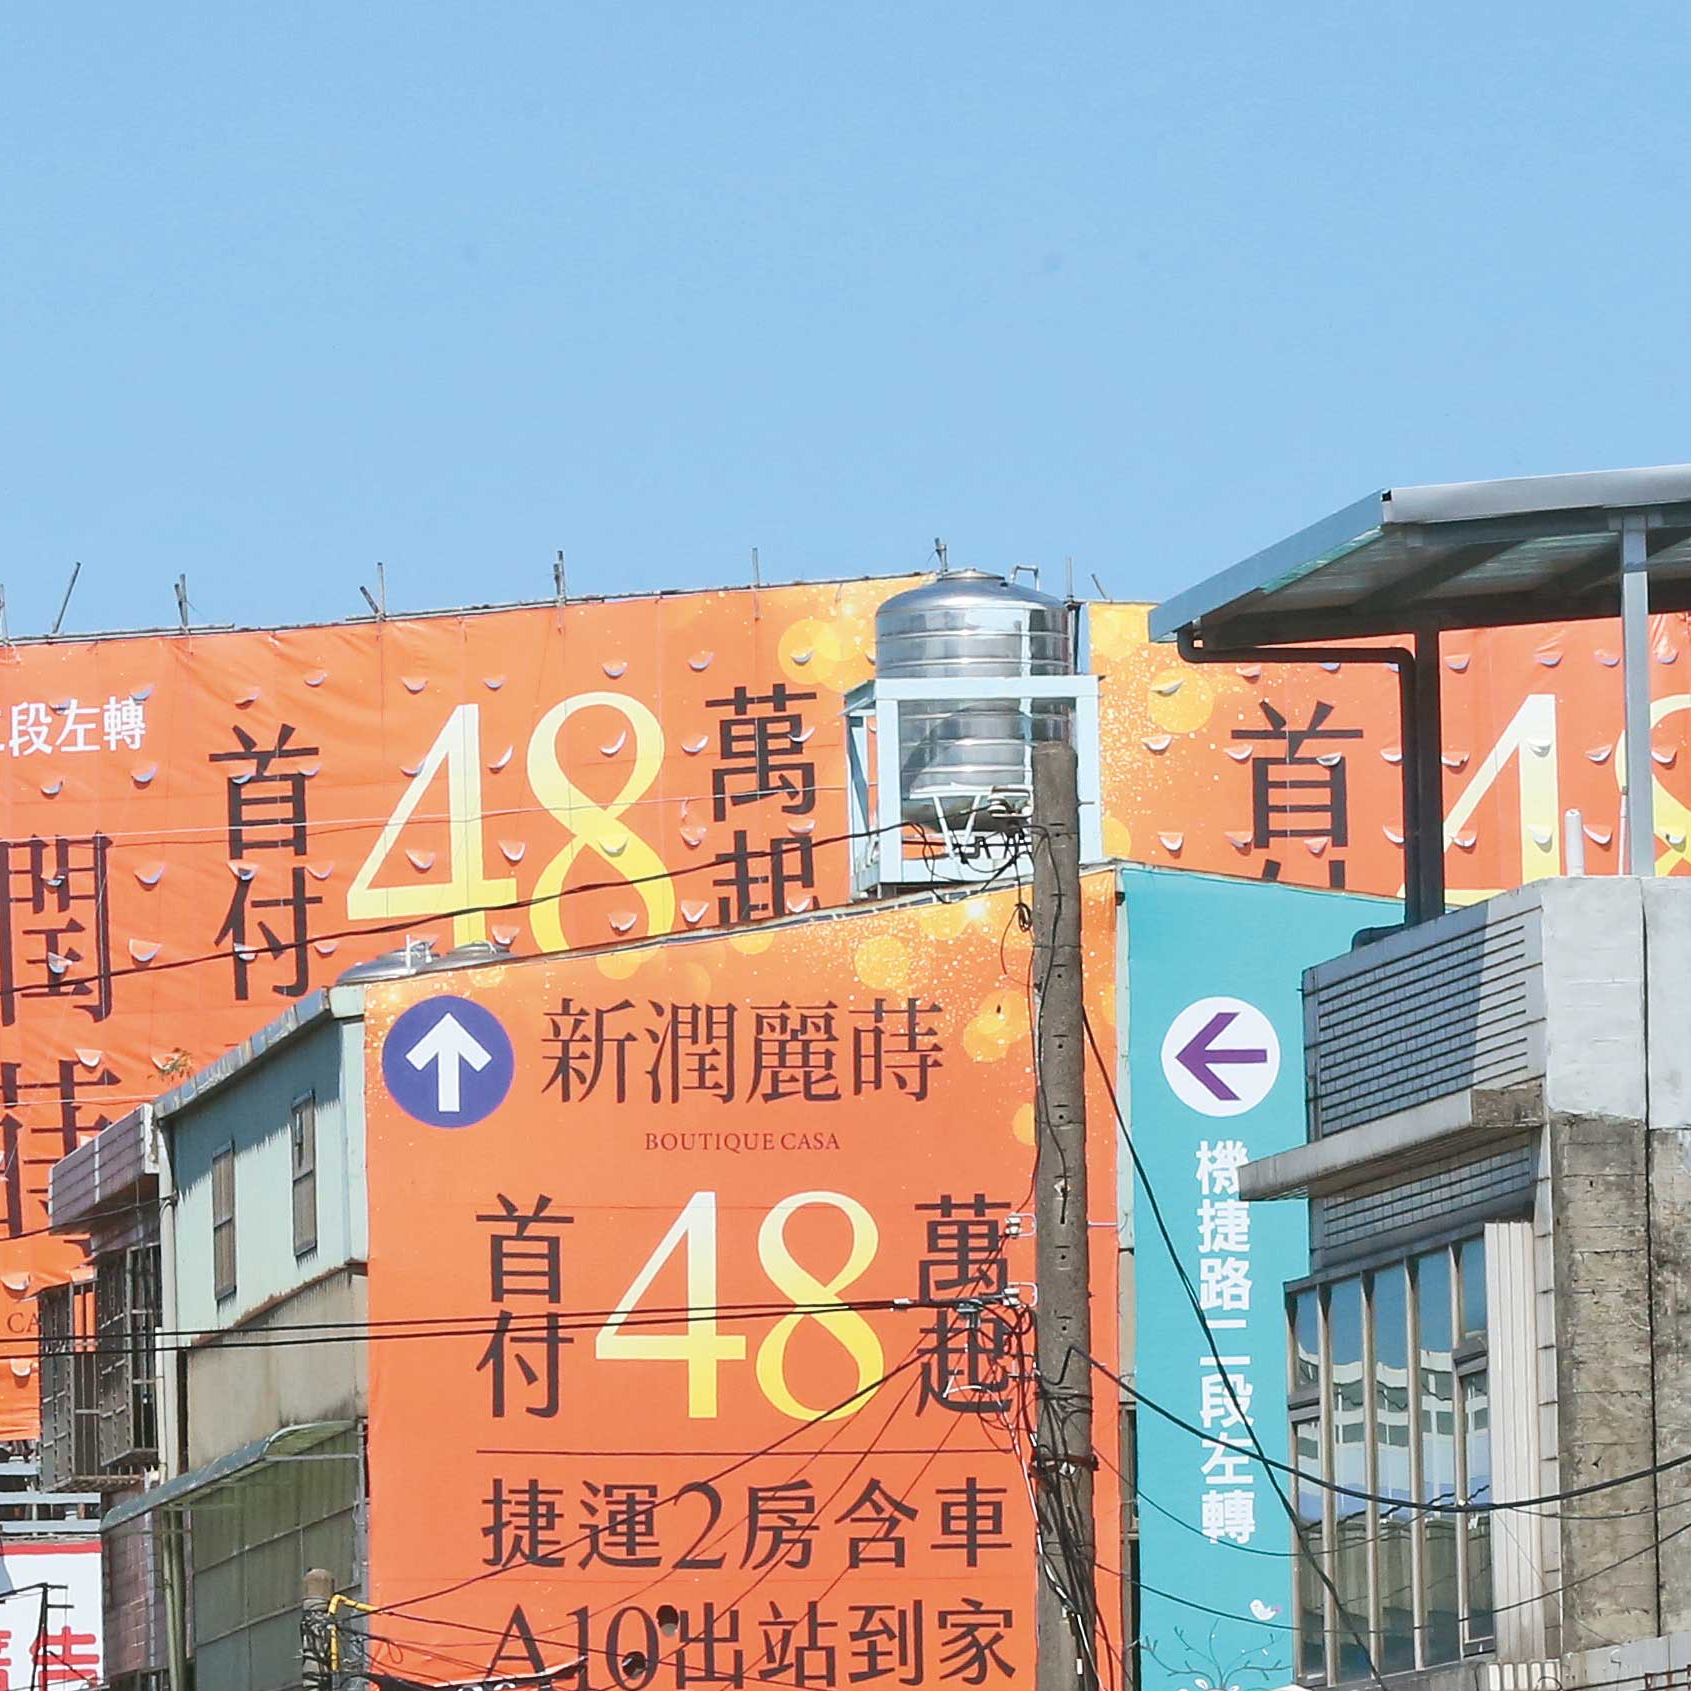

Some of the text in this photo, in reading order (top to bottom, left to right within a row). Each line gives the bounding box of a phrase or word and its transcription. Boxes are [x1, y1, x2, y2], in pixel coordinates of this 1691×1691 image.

[209, 683, 822, 1001] 首付 48 萬起
[1231, 700, 1364, 888] 首
[541, 997, 945, 1105] 新潤麗蒔
[645, 1132, 841, 1154] BOUTIQUE CASA
[475, 1190, 1013, 1422] 首付 48 萬起
[1195, 1140, 1256, 1545] 機捷路二段左轉
[481, 1477, 1013, 1571] 捷運2房含車
